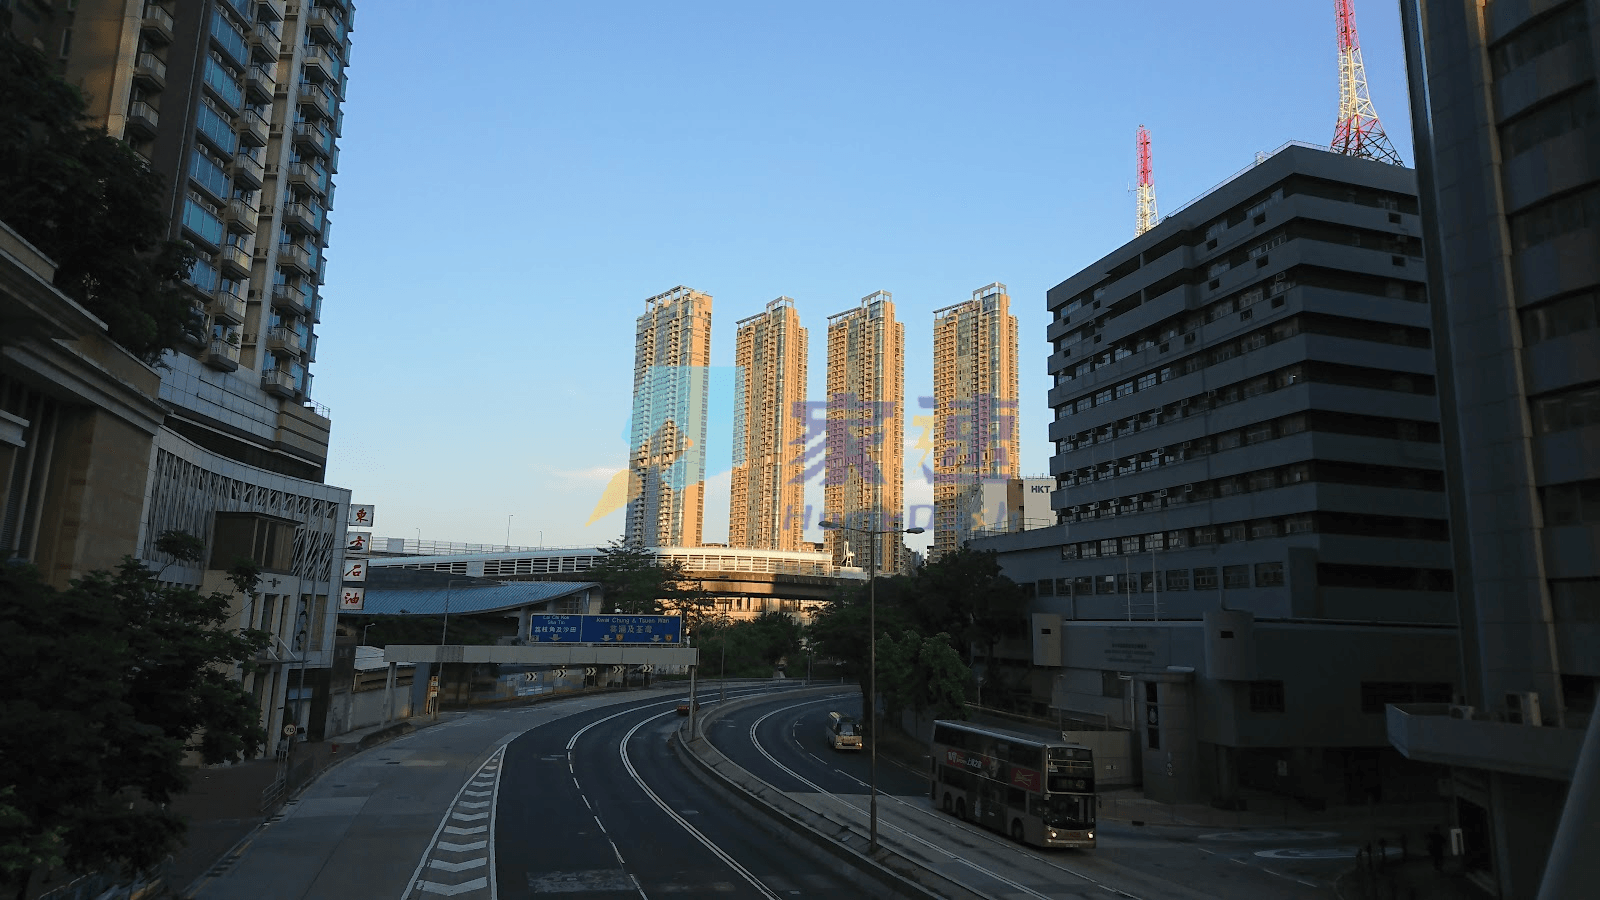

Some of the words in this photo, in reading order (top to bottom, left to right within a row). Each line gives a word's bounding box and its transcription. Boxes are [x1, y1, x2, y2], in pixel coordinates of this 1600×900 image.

[1031, 485, 1051, 494] HKT
[344, 507, 369, 605] 東方石油
[611, 617, 630, 625] Chung
[534, 625, 577, 633] 荔枝角及沙田
